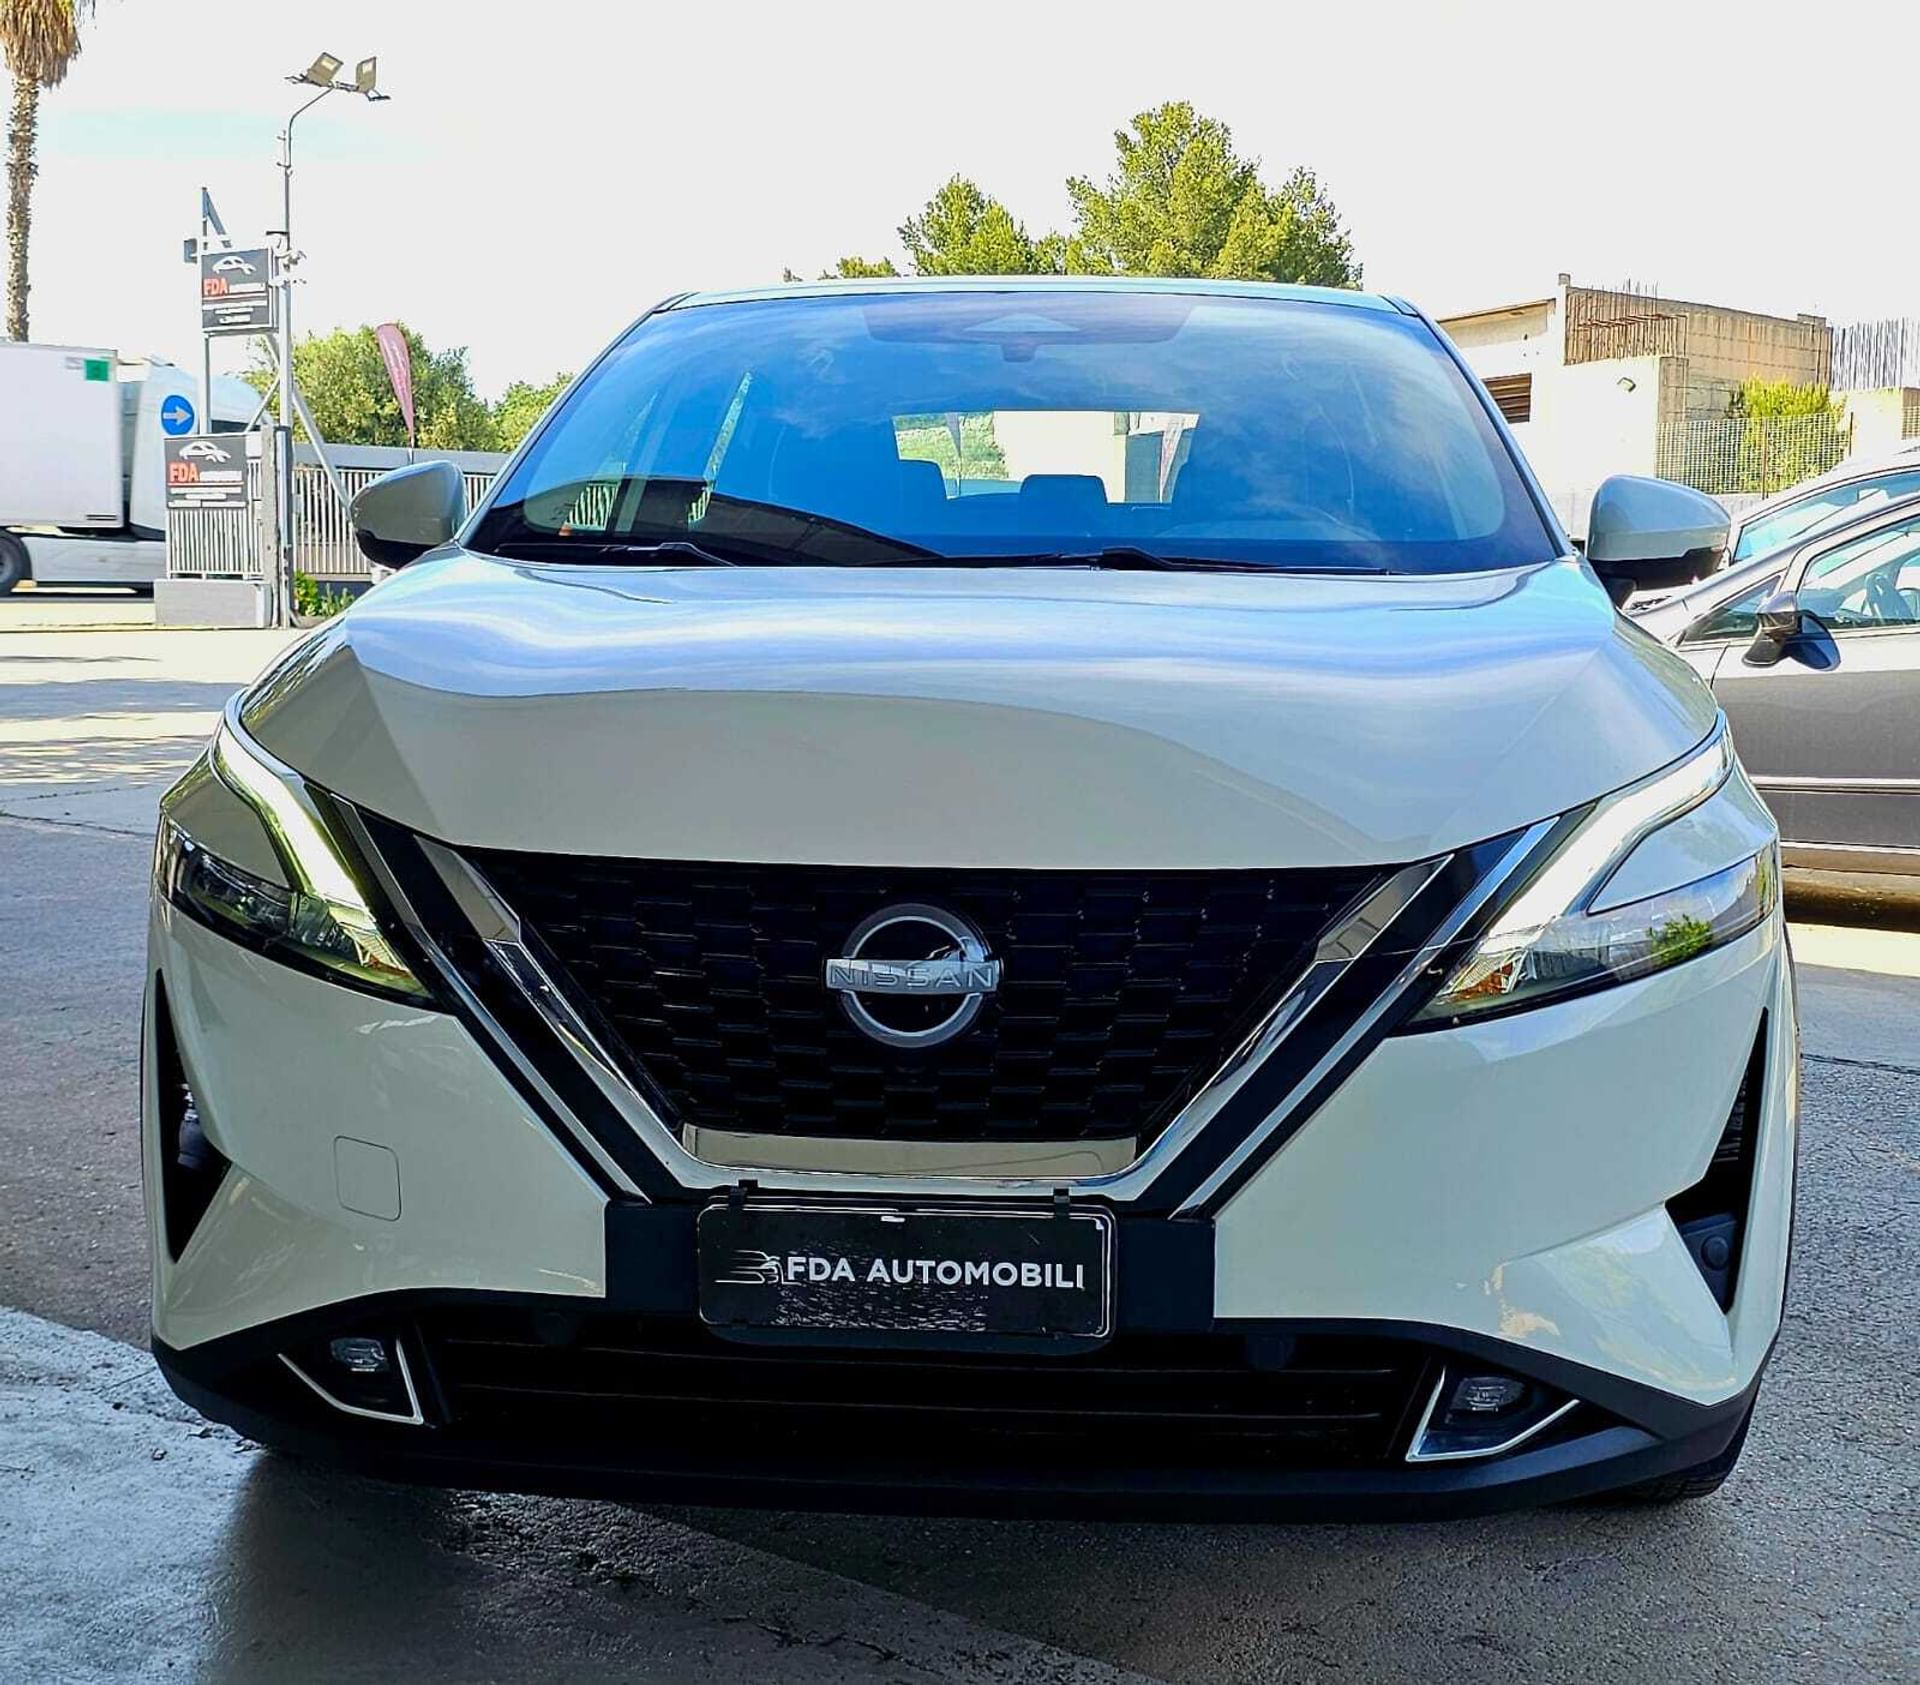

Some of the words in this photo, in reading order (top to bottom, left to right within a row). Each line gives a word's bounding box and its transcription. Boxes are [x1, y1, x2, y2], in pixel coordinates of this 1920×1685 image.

[203, 278, 228, 296] FDA
[169, 462, 199, 482] FDA
[830, 965, 993, 988] NISSAN
[786, 1256, 856, 1283] FDA
[866, 1258, 1084, 1289] AUTOMOBILI
